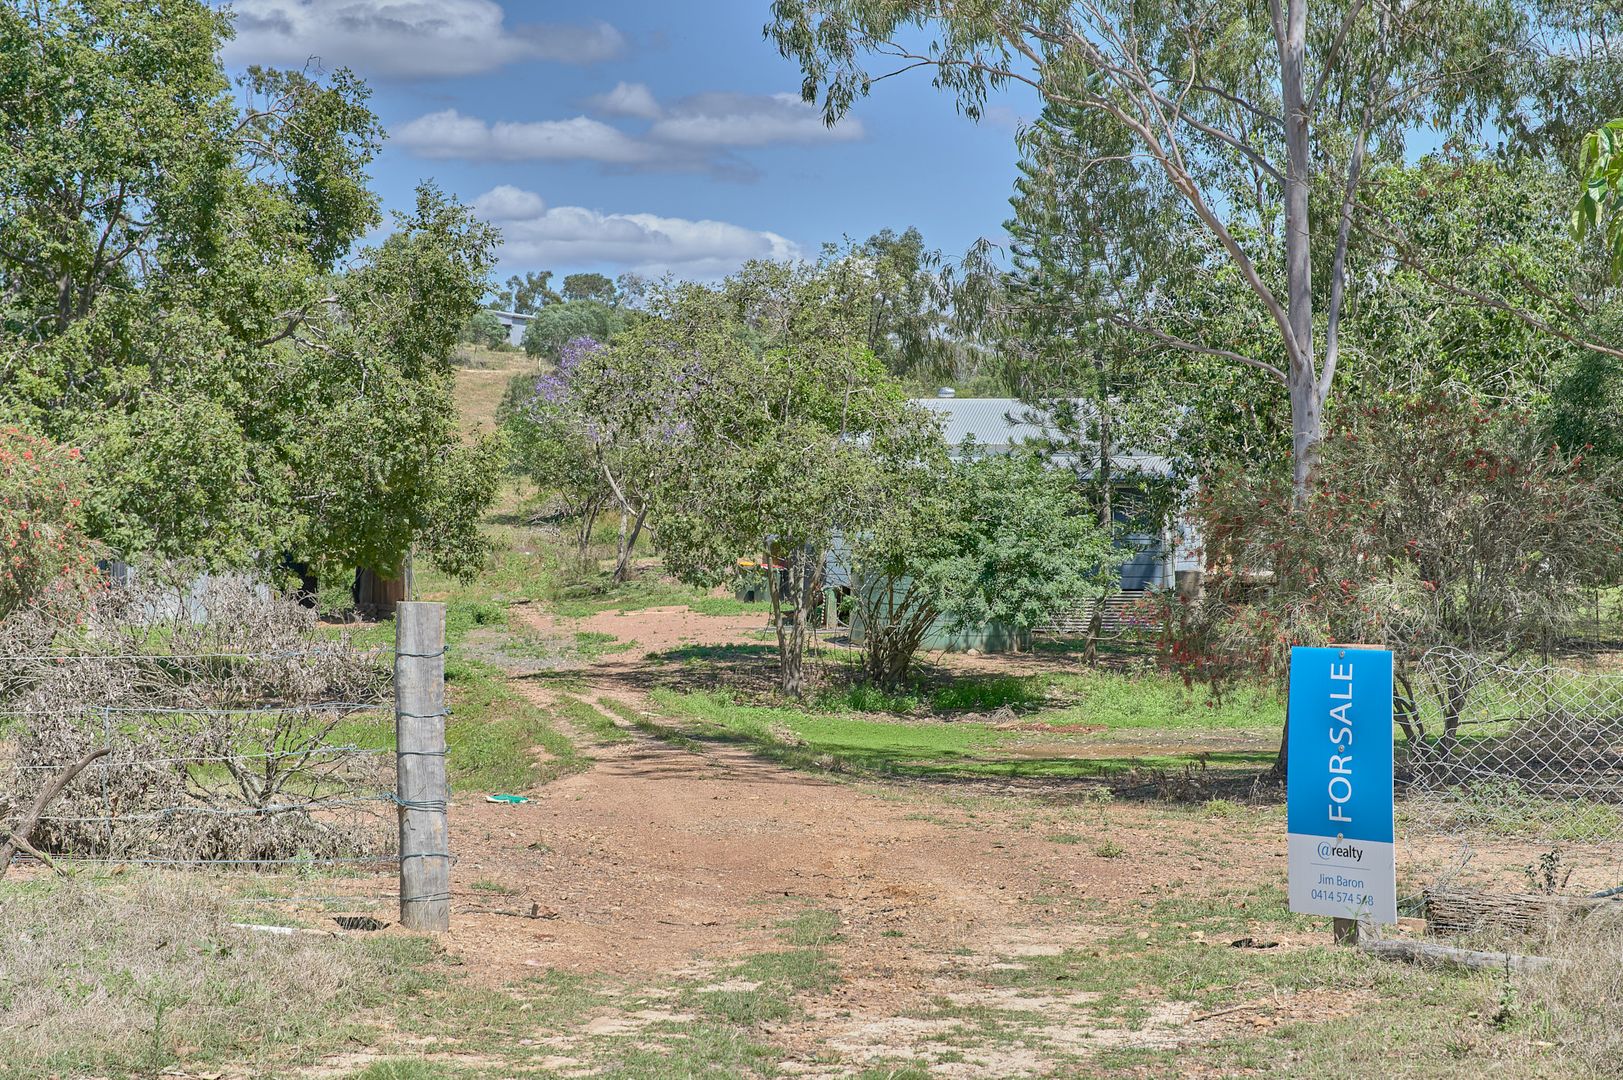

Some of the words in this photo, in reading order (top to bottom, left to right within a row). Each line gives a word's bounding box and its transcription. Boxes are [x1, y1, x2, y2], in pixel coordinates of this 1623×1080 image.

[1329, 663, 1353, 745] SALE
[1328, 755, 1353, 823] FOR
[1317, 841, 1363, 862] @realty
[1318, 874, 1334, 885] Jim
[1336, 875, 1364, 888] Baron
[1311, 889, 1334, 901] 0414
[1336, 892, 1353, 903] 574
